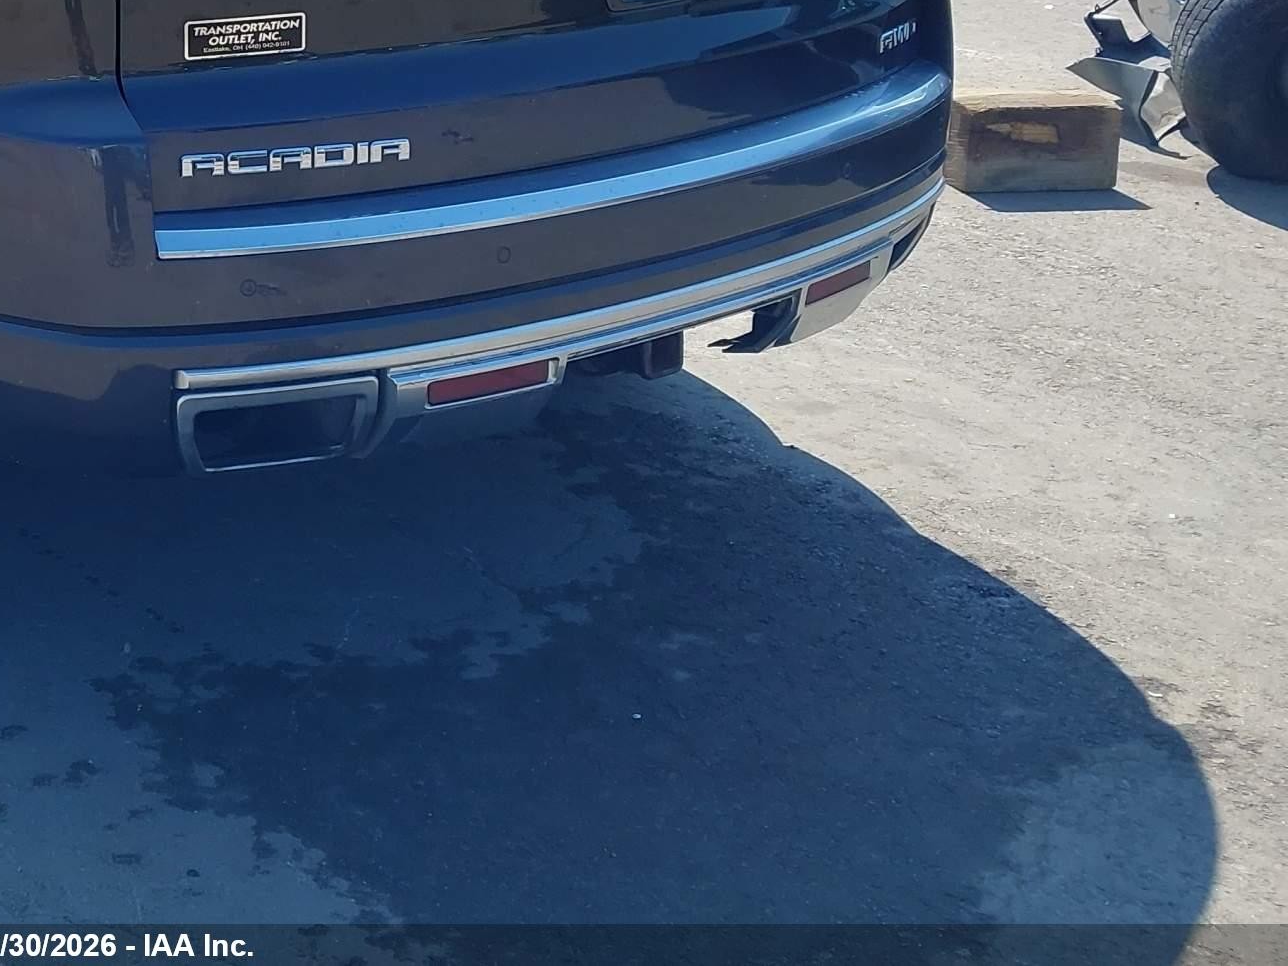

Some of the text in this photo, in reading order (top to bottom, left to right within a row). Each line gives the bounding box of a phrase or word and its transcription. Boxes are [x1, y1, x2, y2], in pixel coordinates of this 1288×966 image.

[193, 19, 300, 36] TRANSPORTATION
[208, 31, 282, 46] OUTLET, INC.
[180, 138, 411, 179] ACADIA
